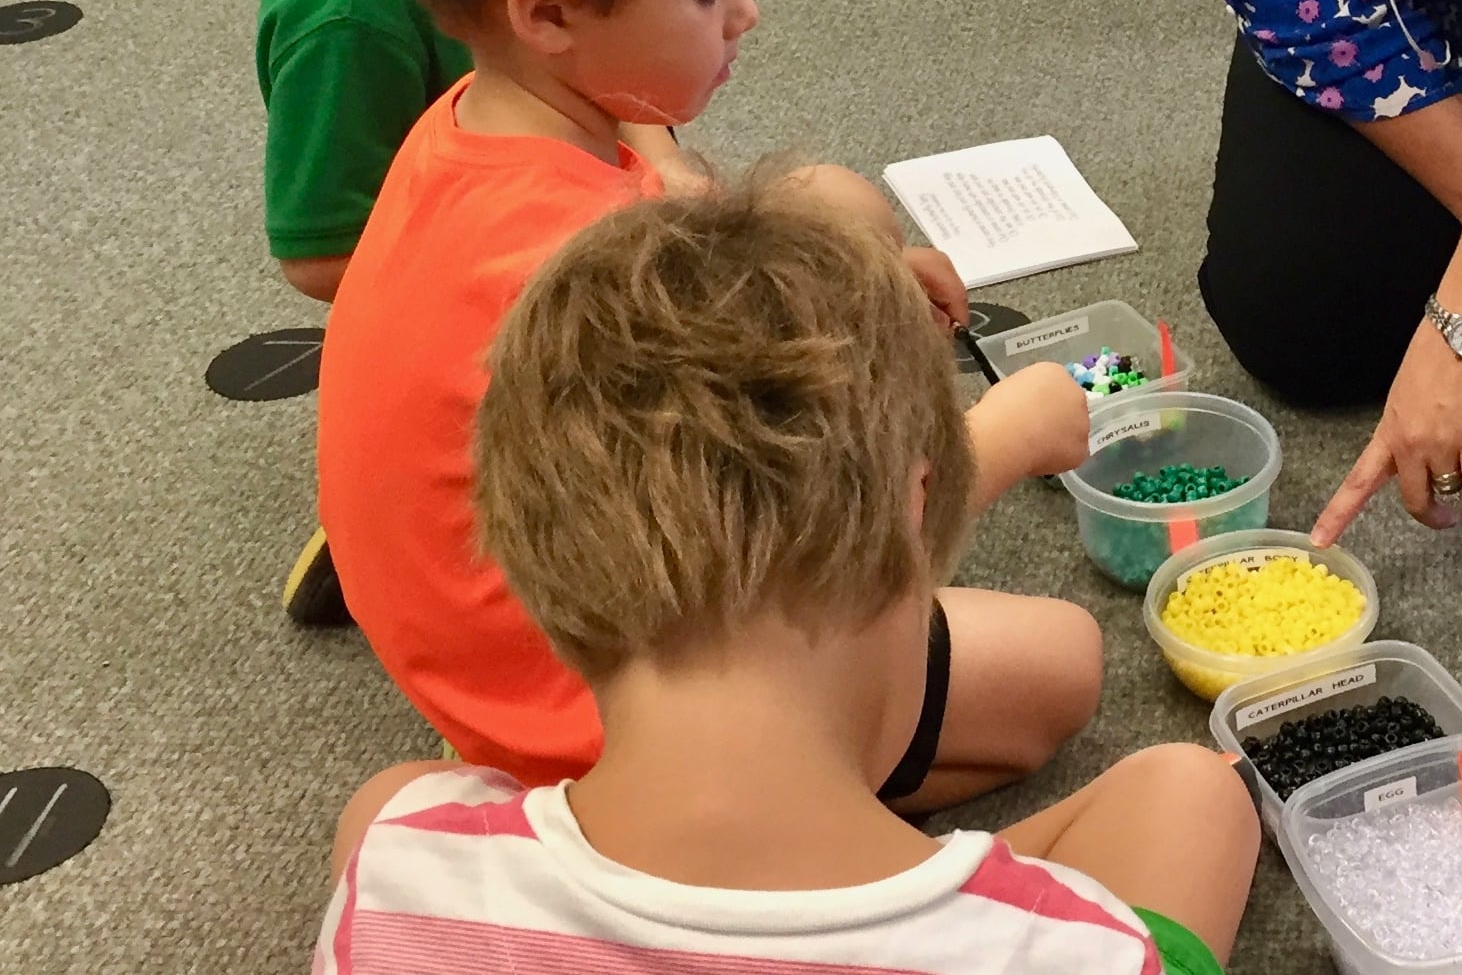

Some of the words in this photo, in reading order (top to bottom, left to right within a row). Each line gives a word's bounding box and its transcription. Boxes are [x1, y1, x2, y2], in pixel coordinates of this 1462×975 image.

[1016, 324, 1080, 349] BUTTERFLIES
[1096, 420, 1150, 445] CHRYSALIS
[1248, 687, 1323, 719] CATERPILLAR
[1332, 674, 1364, 689] HEAD
[1378, 787, 1405, 802] EGG
